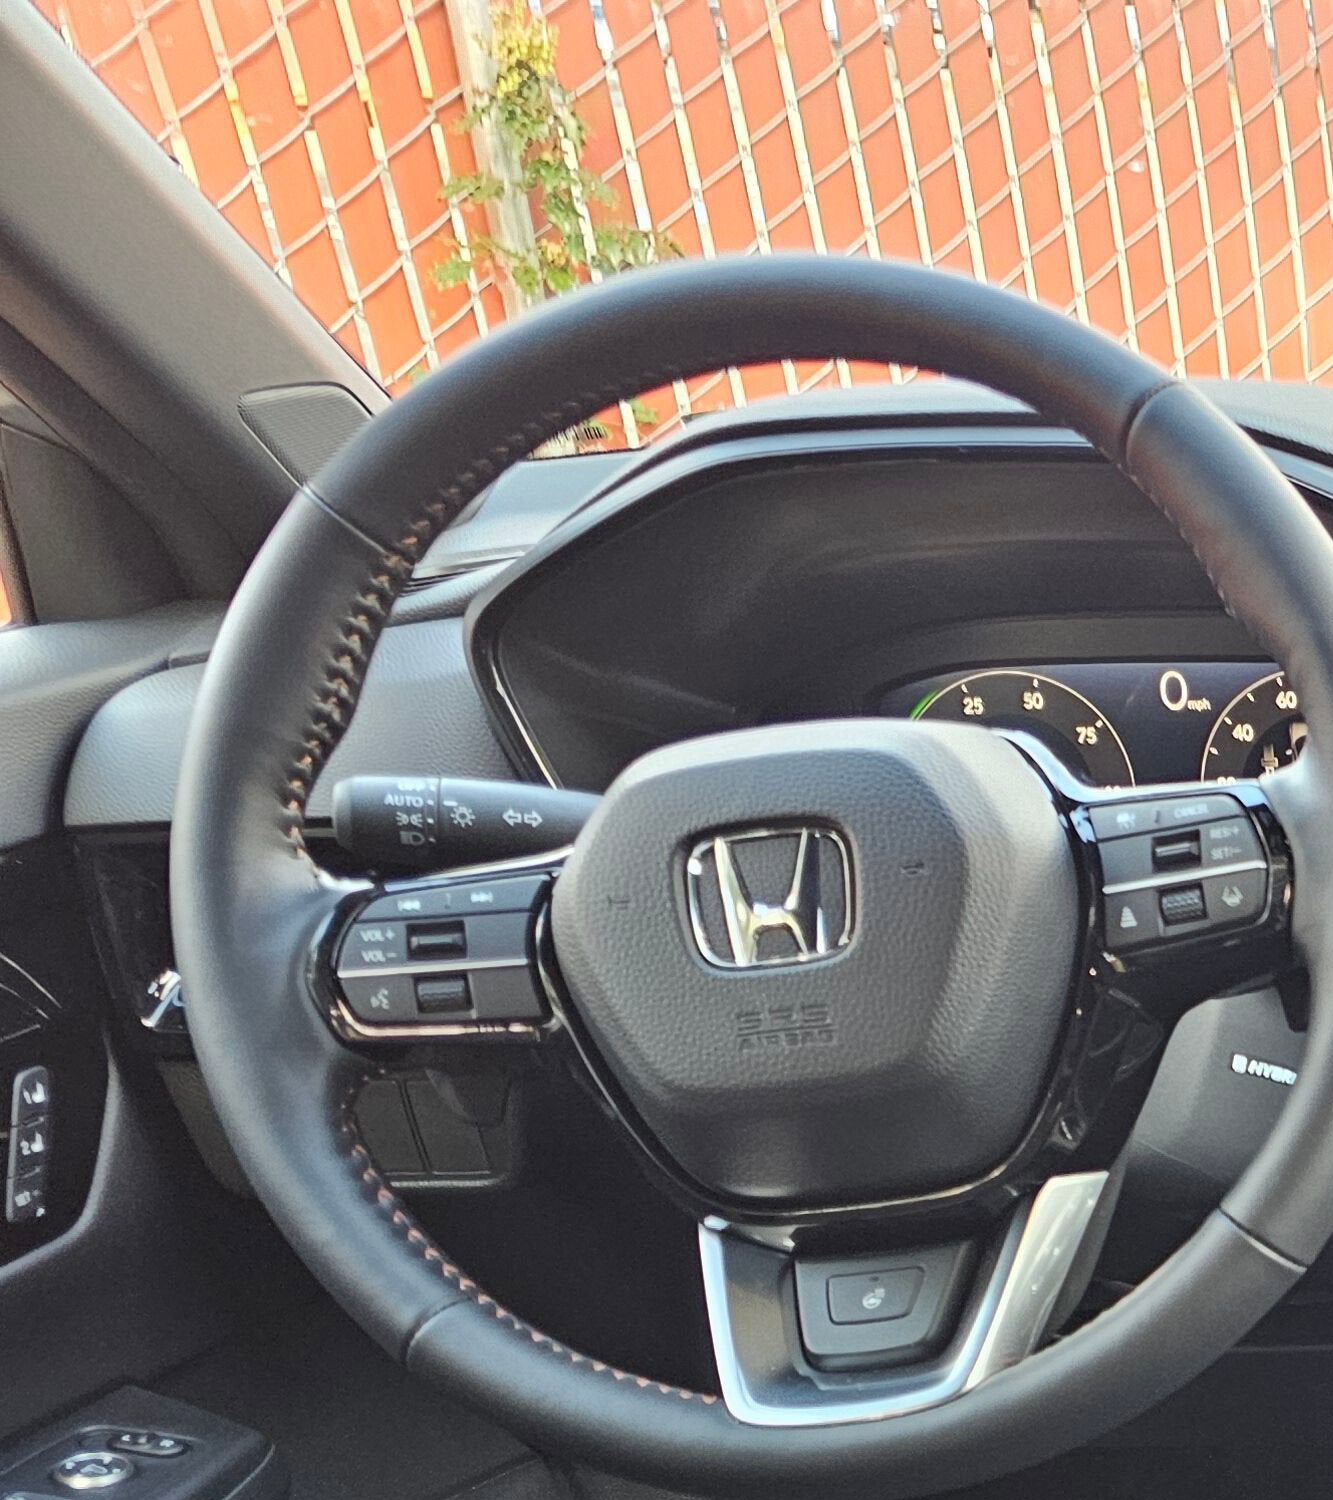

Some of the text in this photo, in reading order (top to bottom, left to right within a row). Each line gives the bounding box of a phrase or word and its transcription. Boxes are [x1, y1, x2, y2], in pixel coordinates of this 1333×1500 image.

[1023, 691, 1044, 710] 50
[1160, 670, 1212, 712] 0 mph
[1276, 690, 1297, 709] 60
[963, 696, 984, 715] 25
[1076, 726, 1098, 745] 75
[1232, 723, 1254, 742] 40
[384, 794, 424, 808] AUTO
[1247, 1059, 1297, 1086] HYBRI
